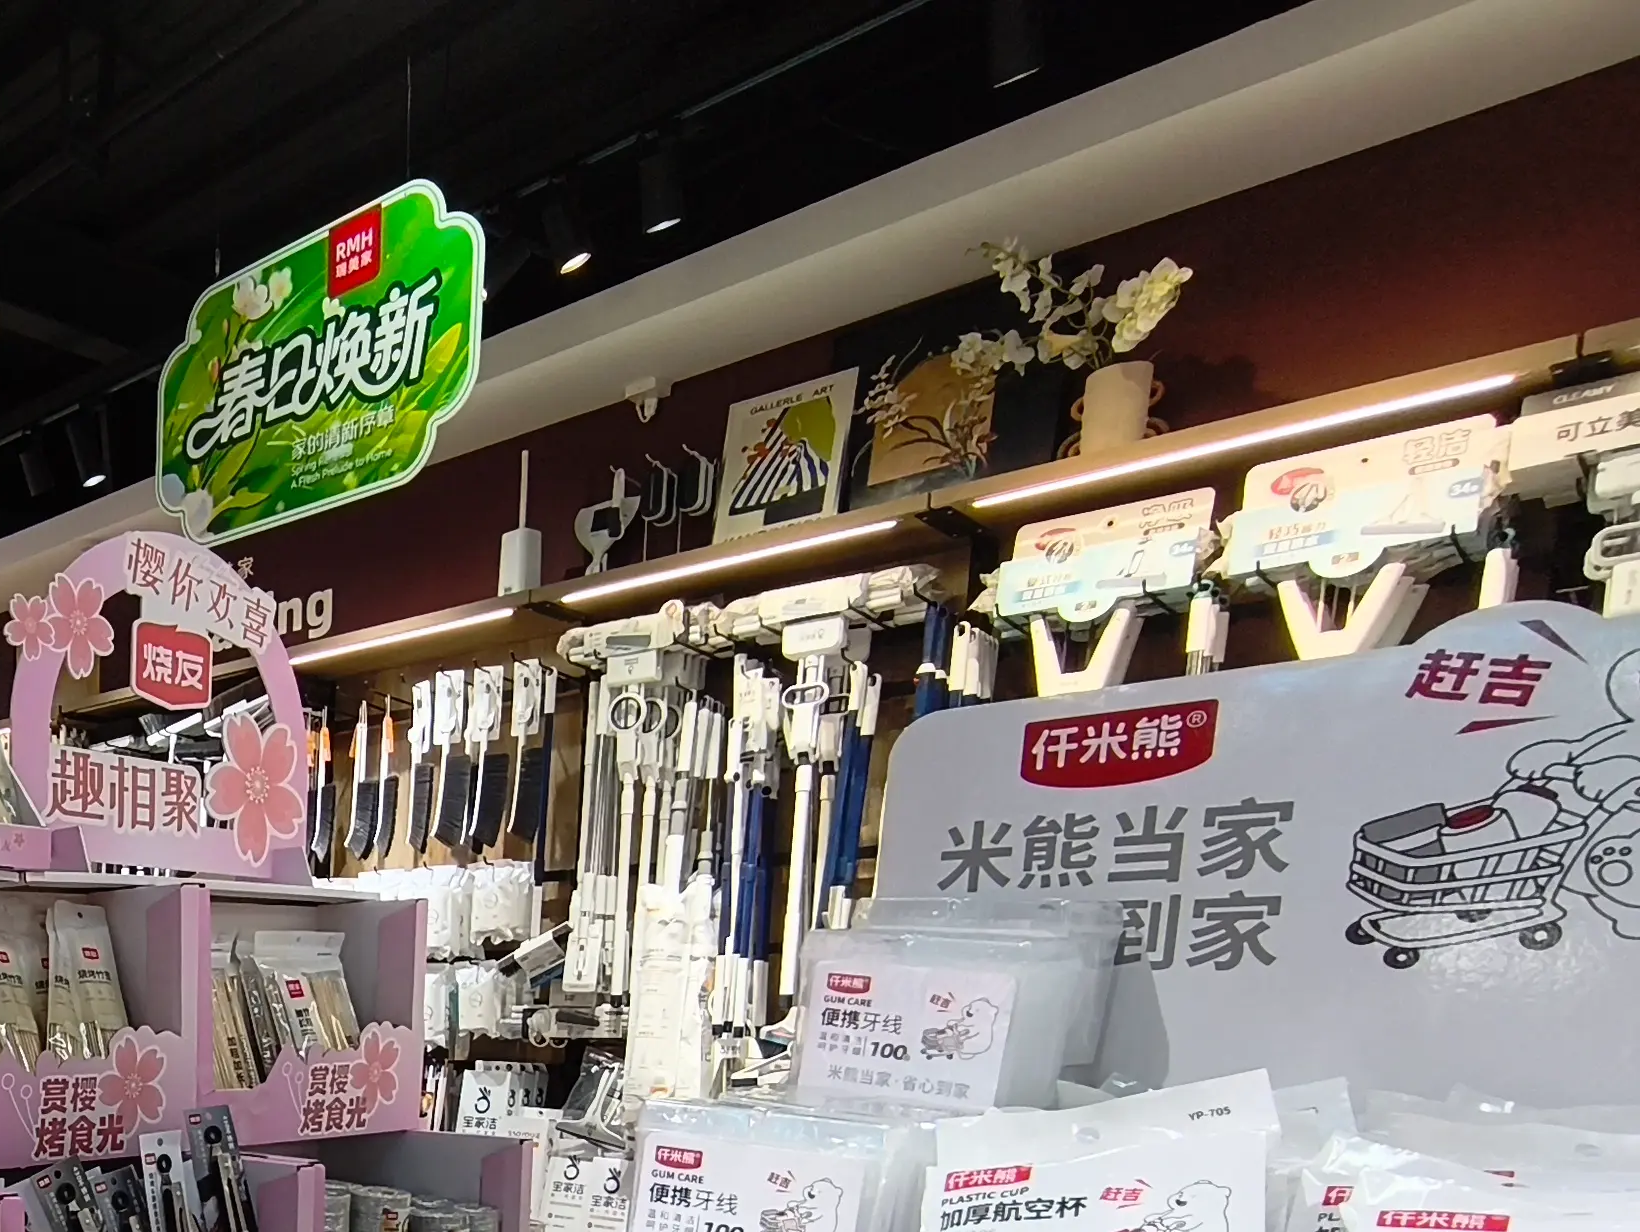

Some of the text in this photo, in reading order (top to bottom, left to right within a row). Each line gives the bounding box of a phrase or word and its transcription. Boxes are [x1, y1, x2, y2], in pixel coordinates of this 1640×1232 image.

[336, 227, 374, 262] RMH
[187, 275, 438, 459] 春日焕新
[127, 537, 273, 649] 樱你欢喜
[143, 642, 204, 691] 烧友
[1405, 648, 1553, 708] 赶吉
[47, 750, 200, 833] 趣相聚
[937, 798, 1294, 893] 米熊当家
[823, 995, 873, 1008] GUM CARE
[821, 1007, 903, 1036] 便携牙线
[870, 1040, 908, 1062] 100
[41, 1077, 99, 1115] 赏樱
[309, 1062, 352, 1096] 赏樱
[299, 1096, 367, 1135] 烤食光
[1187, 1105, 1232, 1121] YP-705
[34, 1113, 126, 1159] 烤食光
[651, 1169, 705, 1185] GUM CARE
[1099, 1186, 1145, 1203] 赶吉
[649, 1182, 738, 1217] 便携牙线
[940, 1195, 1088, 1232] 加厚航空杯
[941, 1186, 1030, 1208] PLASTIC CUP
